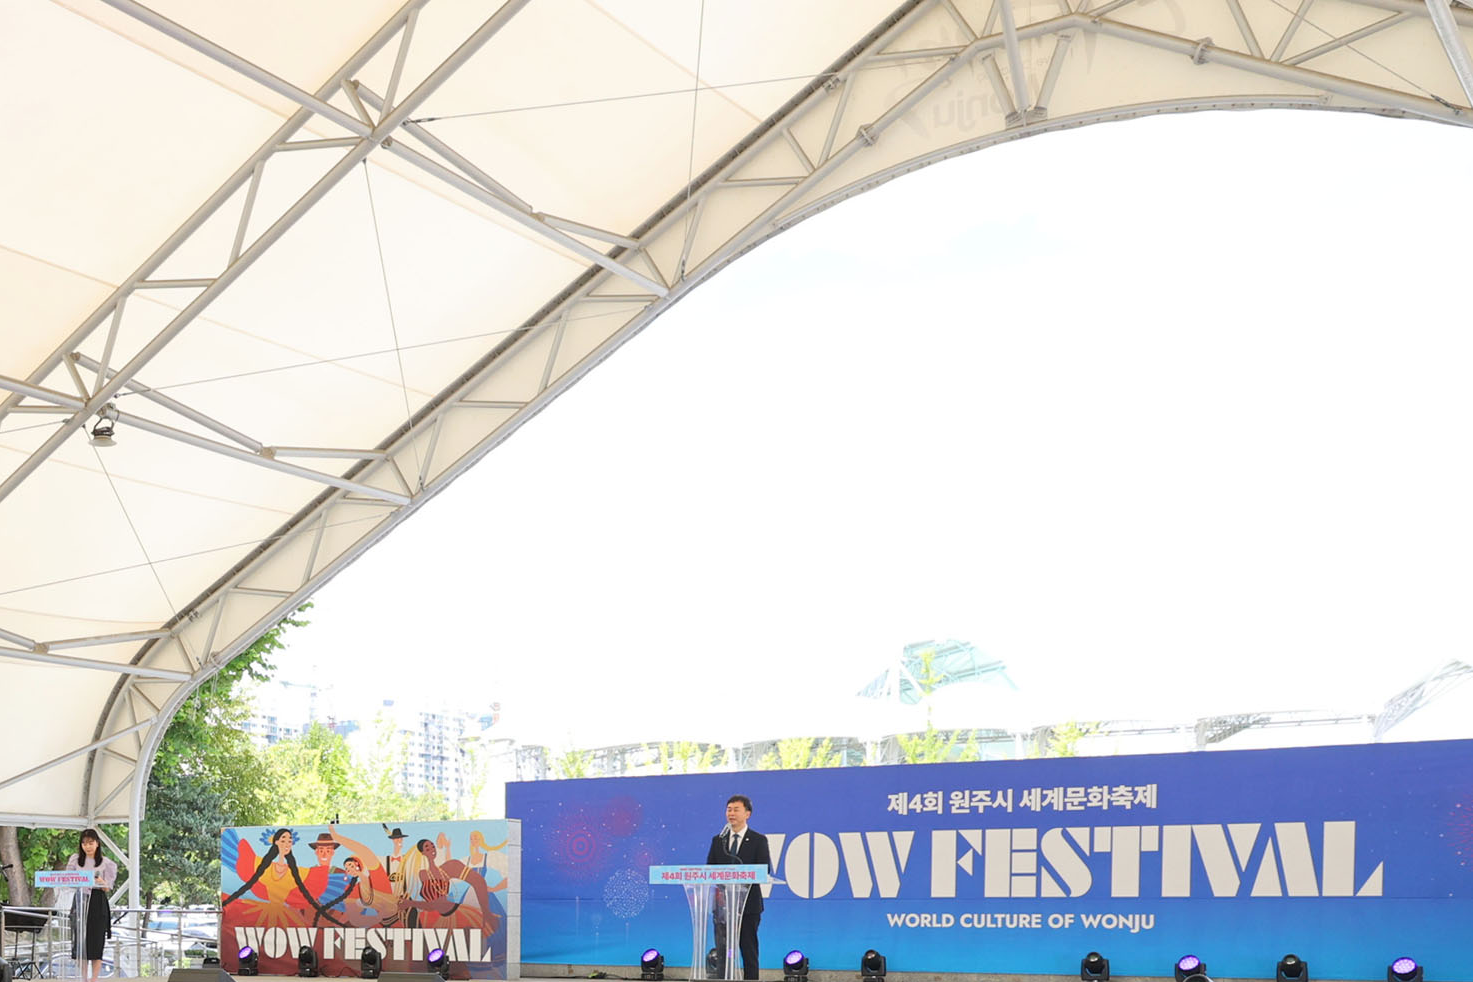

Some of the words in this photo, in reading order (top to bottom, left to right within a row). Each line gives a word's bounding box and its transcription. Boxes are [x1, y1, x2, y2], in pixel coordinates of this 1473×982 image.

[887, 790, 943, 816] 제4회
[949, 788, 1013, 814] 원주시
[1019, 784, 1158, 811] 세계문화축제
[930, 821, 1384, 898] FESTIVAL
[886, 914, 955, 928] WORLD
[960, 913, 1042, 929] CULTURE
[1047, 913, 1074, 928] OF
[1081, 913, 1155, 934] WONJU
[234, 926, 319, 959] WOW
[323, 927, 492, 962] FESTIVAL
